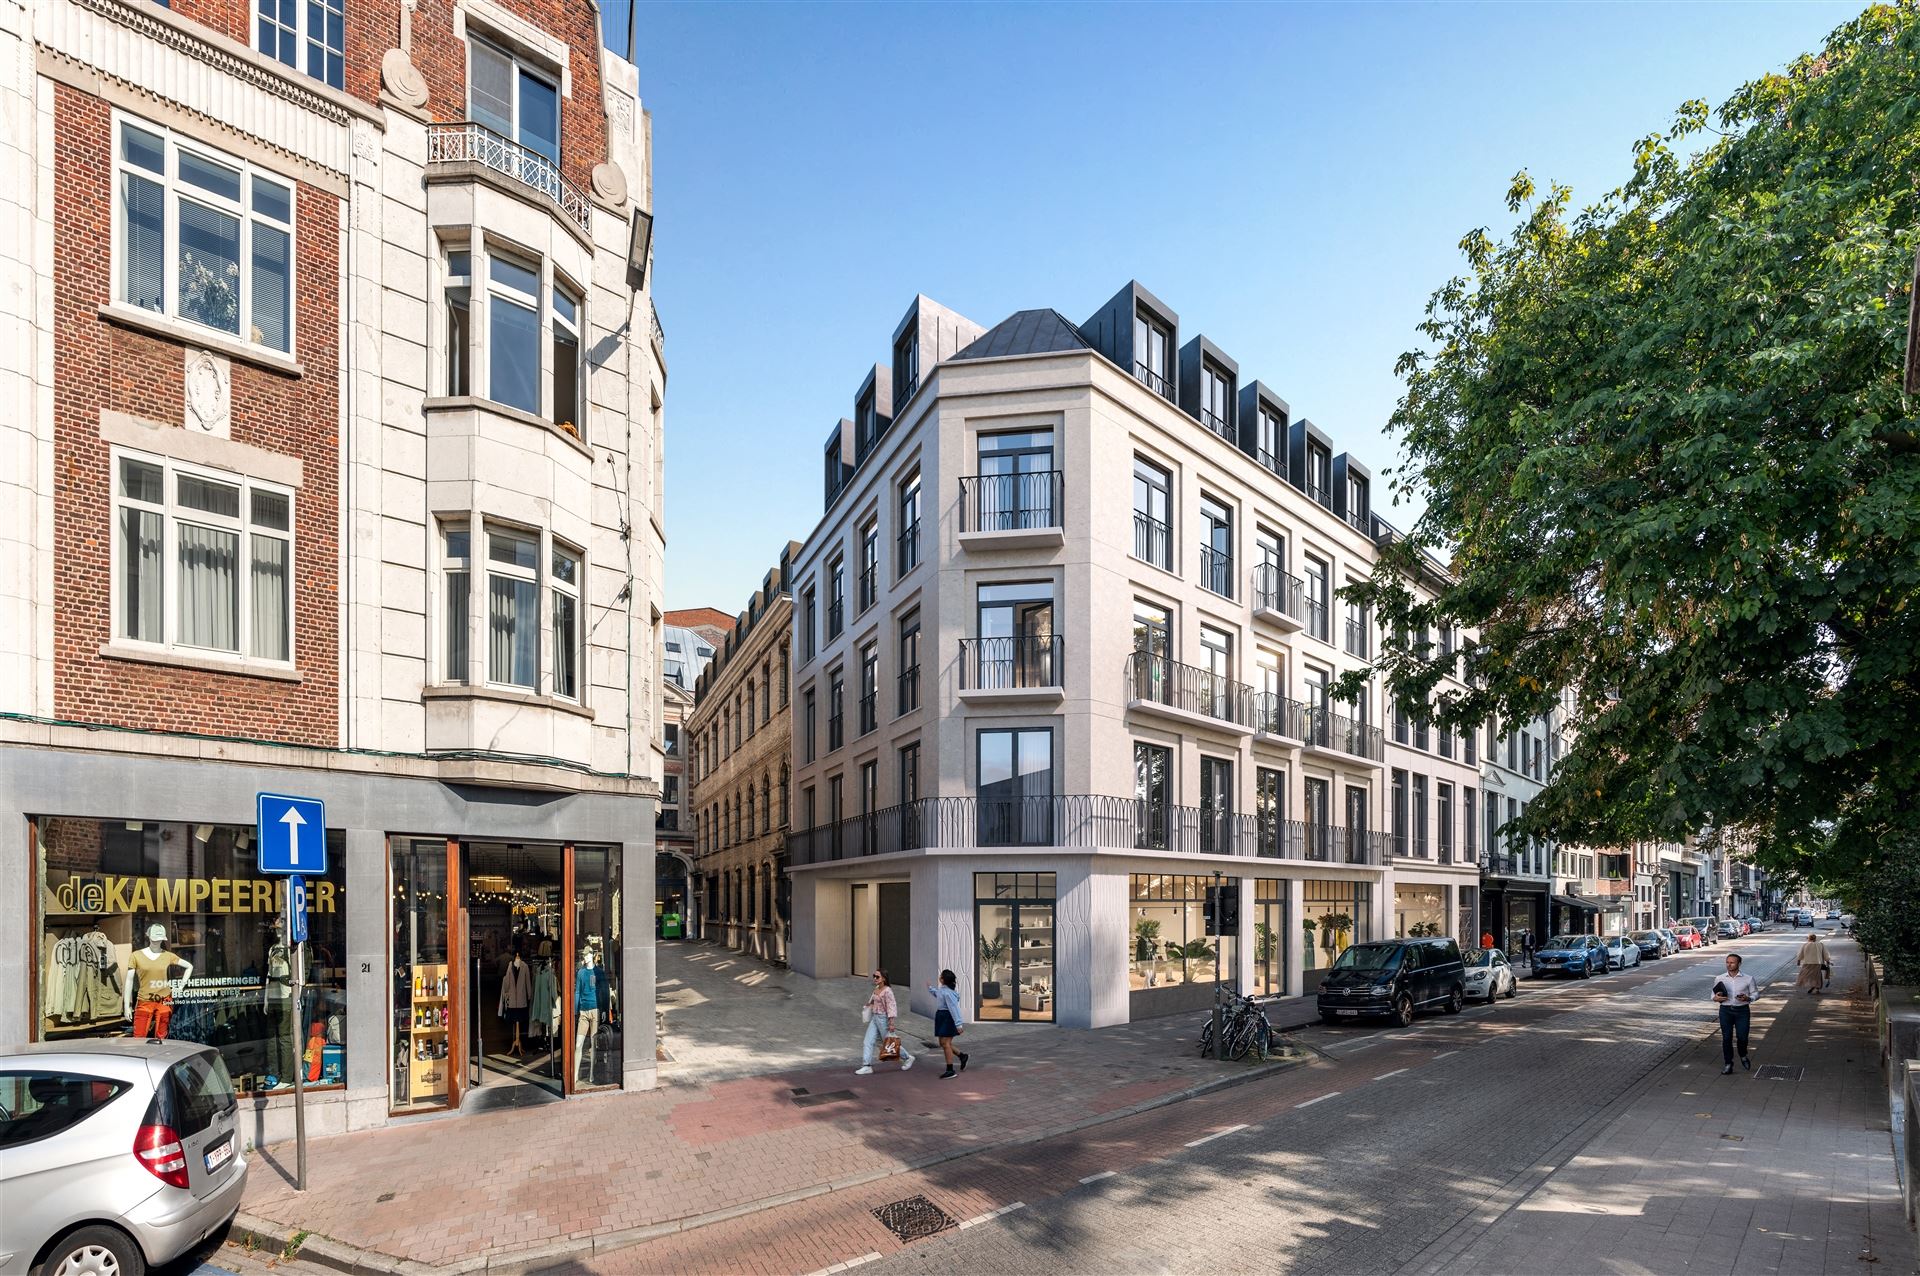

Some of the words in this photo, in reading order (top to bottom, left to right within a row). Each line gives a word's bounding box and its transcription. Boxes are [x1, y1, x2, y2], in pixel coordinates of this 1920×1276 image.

[361, 962, 370, 973] 21
[171, 988, 218, 998] BEGINNEN
[220, 988, 241, 996] HIER
